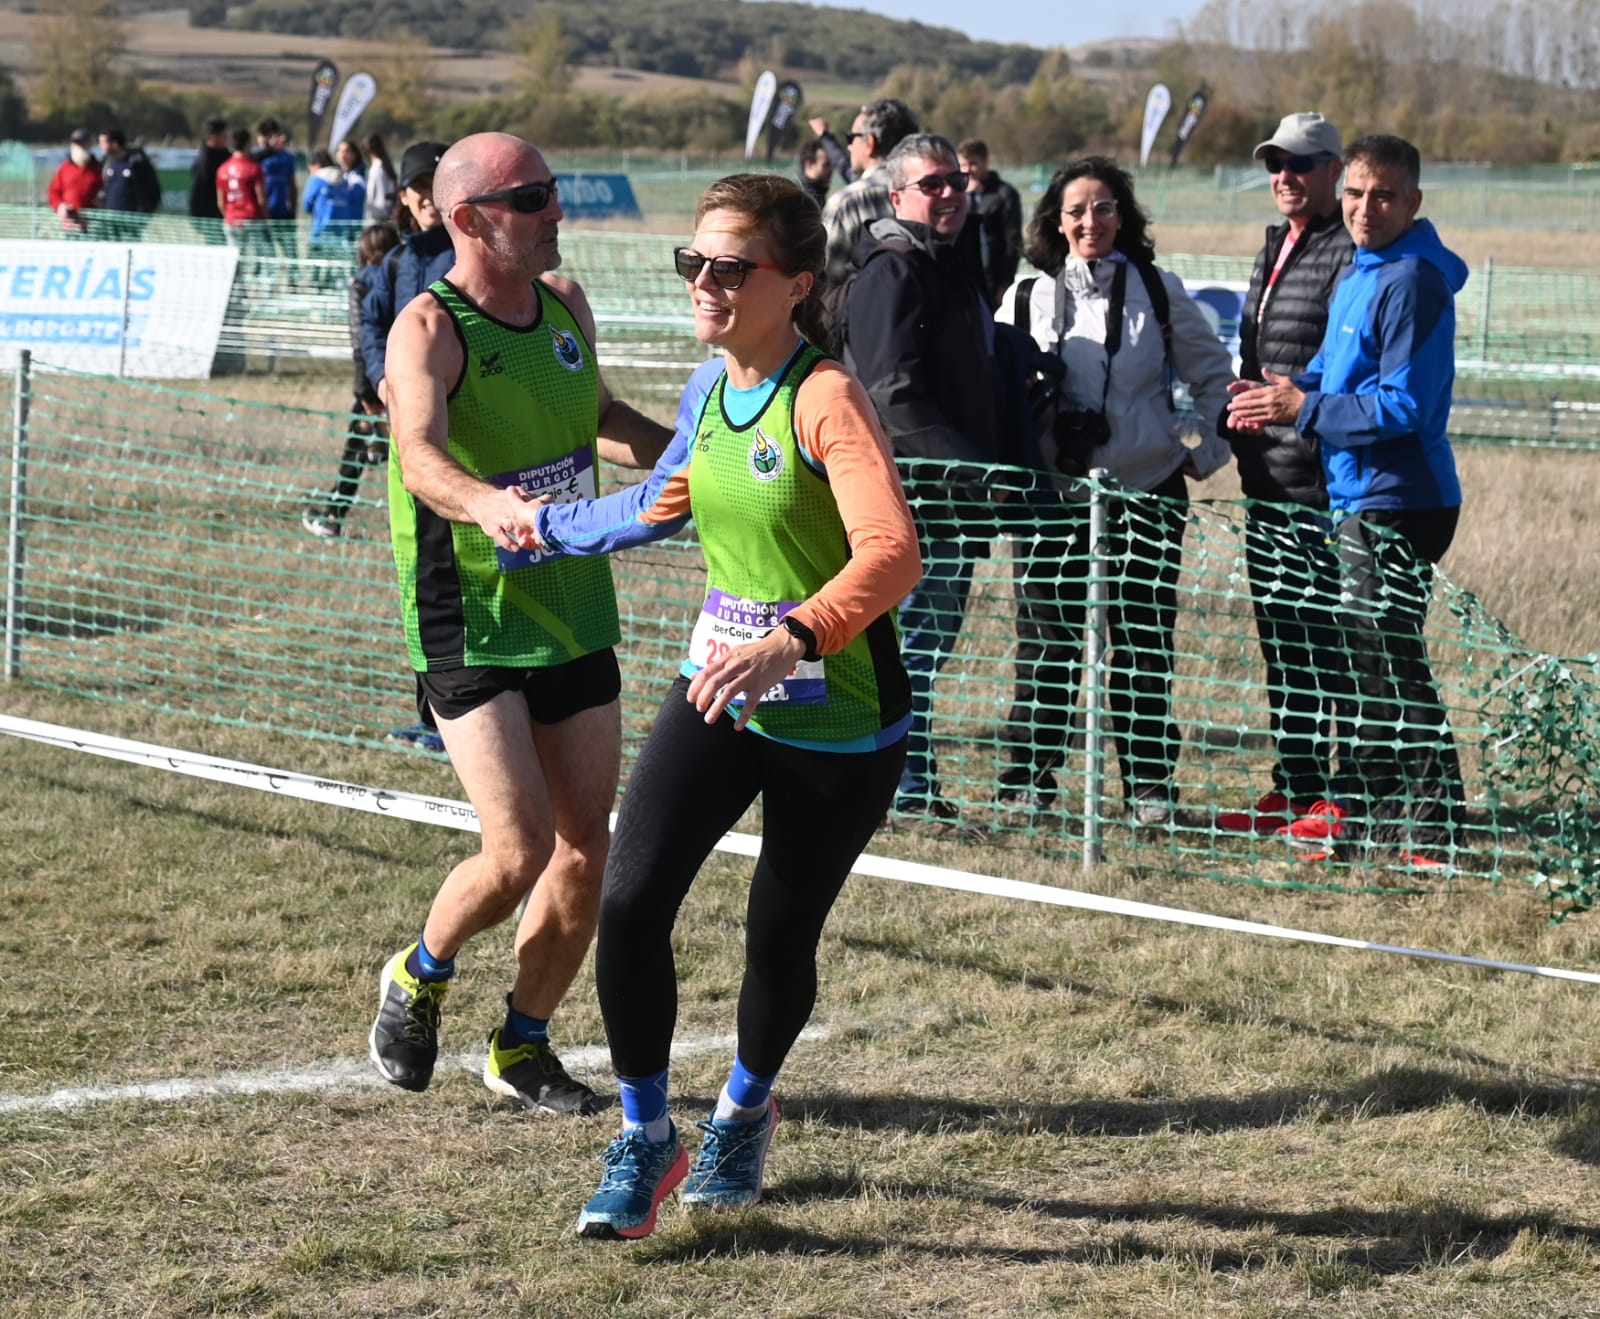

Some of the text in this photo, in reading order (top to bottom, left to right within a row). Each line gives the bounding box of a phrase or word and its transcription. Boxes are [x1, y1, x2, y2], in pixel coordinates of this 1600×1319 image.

[555, 179, 614, 204] NDO
[0, 257, 156, 300] ERÍAS
[518, 456, 574, 481] DIPUTACIÓN
[520, 467, 575, 491] BURGOS
